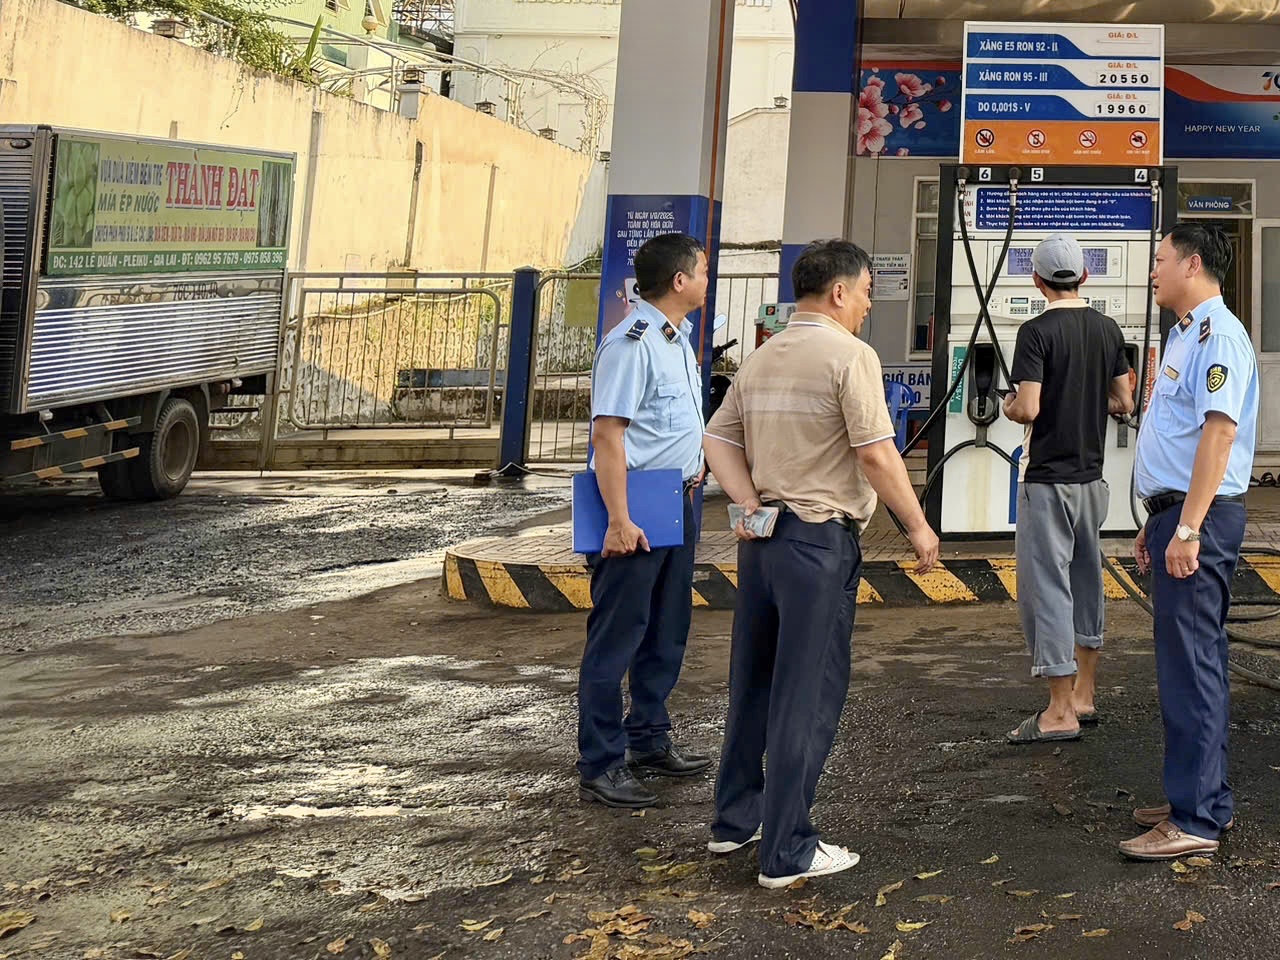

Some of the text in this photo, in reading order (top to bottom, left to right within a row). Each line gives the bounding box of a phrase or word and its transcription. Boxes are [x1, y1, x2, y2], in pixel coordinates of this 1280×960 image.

[979, 39, 1003, 51] XĂNG
[1004, 41, 1015, 51] E5
[1016, 41, 1034, 52] RON
[1035, 42, 1046, 52] 92
[978, 70, 1048, 82] XĂNG RON 95 III
[1099, 73, 1149, 84] 20550
[978, 102, 1031, 113] DO 0,001S V
[1096, 104, 1147, 114] 19960
[1184, 125, 1261, 133] HAPPY NEW YEAR
[980, 169, 990, 180] 6
[1033, 169, 1041, 180] 5
[1136, 170, 1145, 181] 4
[166, 151, 260, 222] THÀNH ĐẠT
[98, 188, 160, 213] MÍA ÉP NƯỚC
[1188, 199, 1204, 208] VĂN
[69, 254, 84, 268] 142
[85, 252, 96, 268] LÊ
[123, 254, 149, 267] PLEIKU
[153, 254, 164, 266] GIA
[166, 253, 177, 266] LAI
